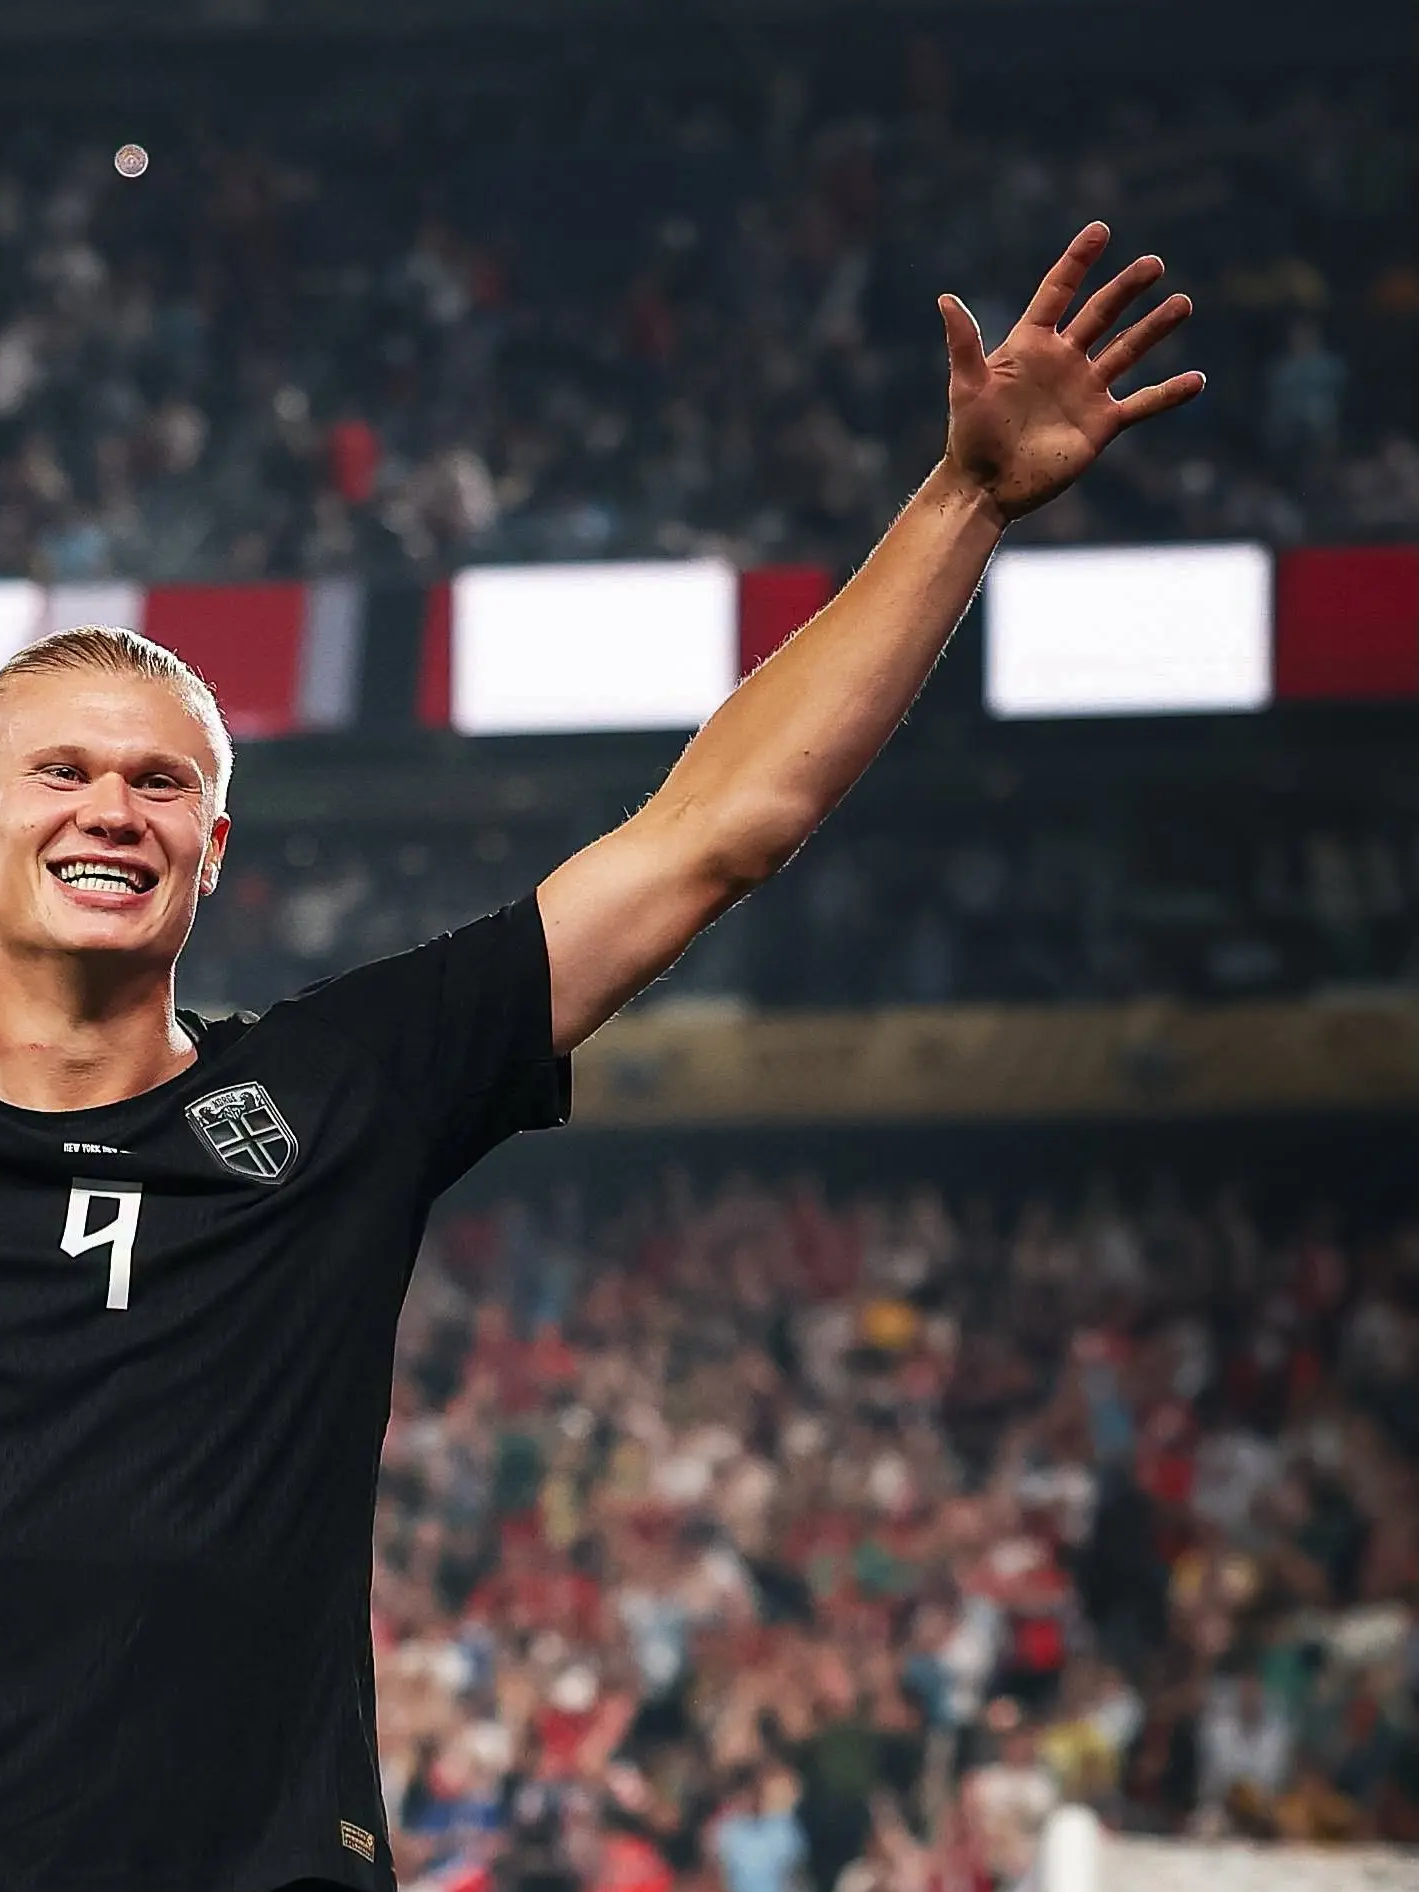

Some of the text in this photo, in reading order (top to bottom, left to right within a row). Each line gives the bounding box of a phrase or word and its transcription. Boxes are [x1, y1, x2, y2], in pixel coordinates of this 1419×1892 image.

[63, 1142, 80, 1153] NEW
[81, 1143, 101, 1154] YORK
[59, 1177, 142, 1311] 9
